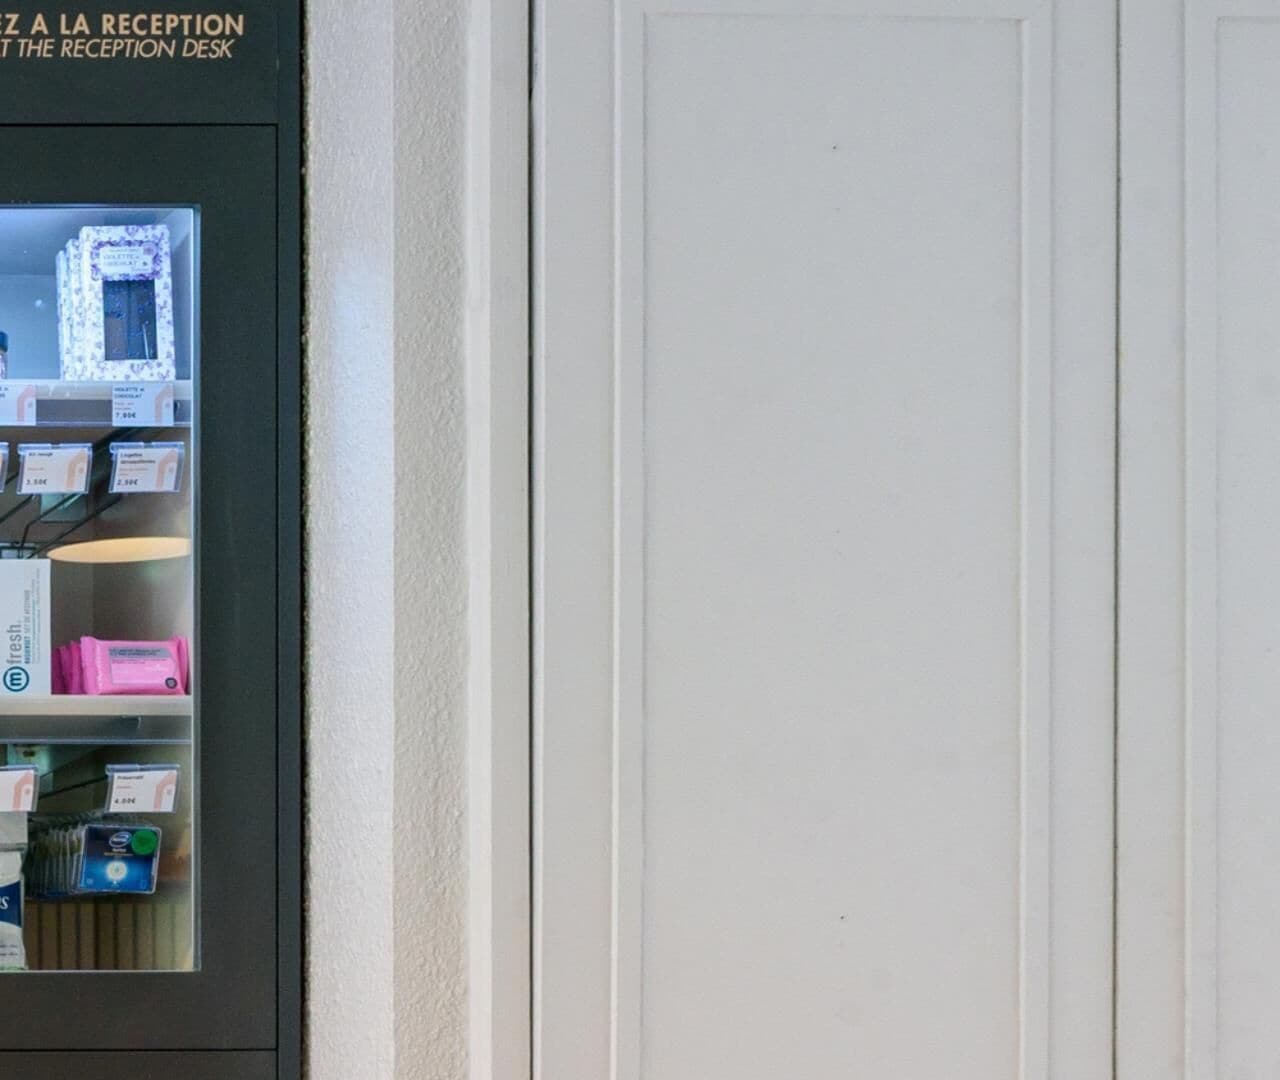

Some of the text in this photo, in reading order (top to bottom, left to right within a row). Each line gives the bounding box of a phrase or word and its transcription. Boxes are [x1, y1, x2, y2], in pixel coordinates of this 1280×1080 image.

[59, 13, 92, 36] LA
[101, 13, 245, 37] RECEPTION
[15, 39, 55, 57] THE
[60, 38, 178, 58] RECEPTION
[181, 38, 236, 58] DESK
[6, 624, 22, 665] fresh
